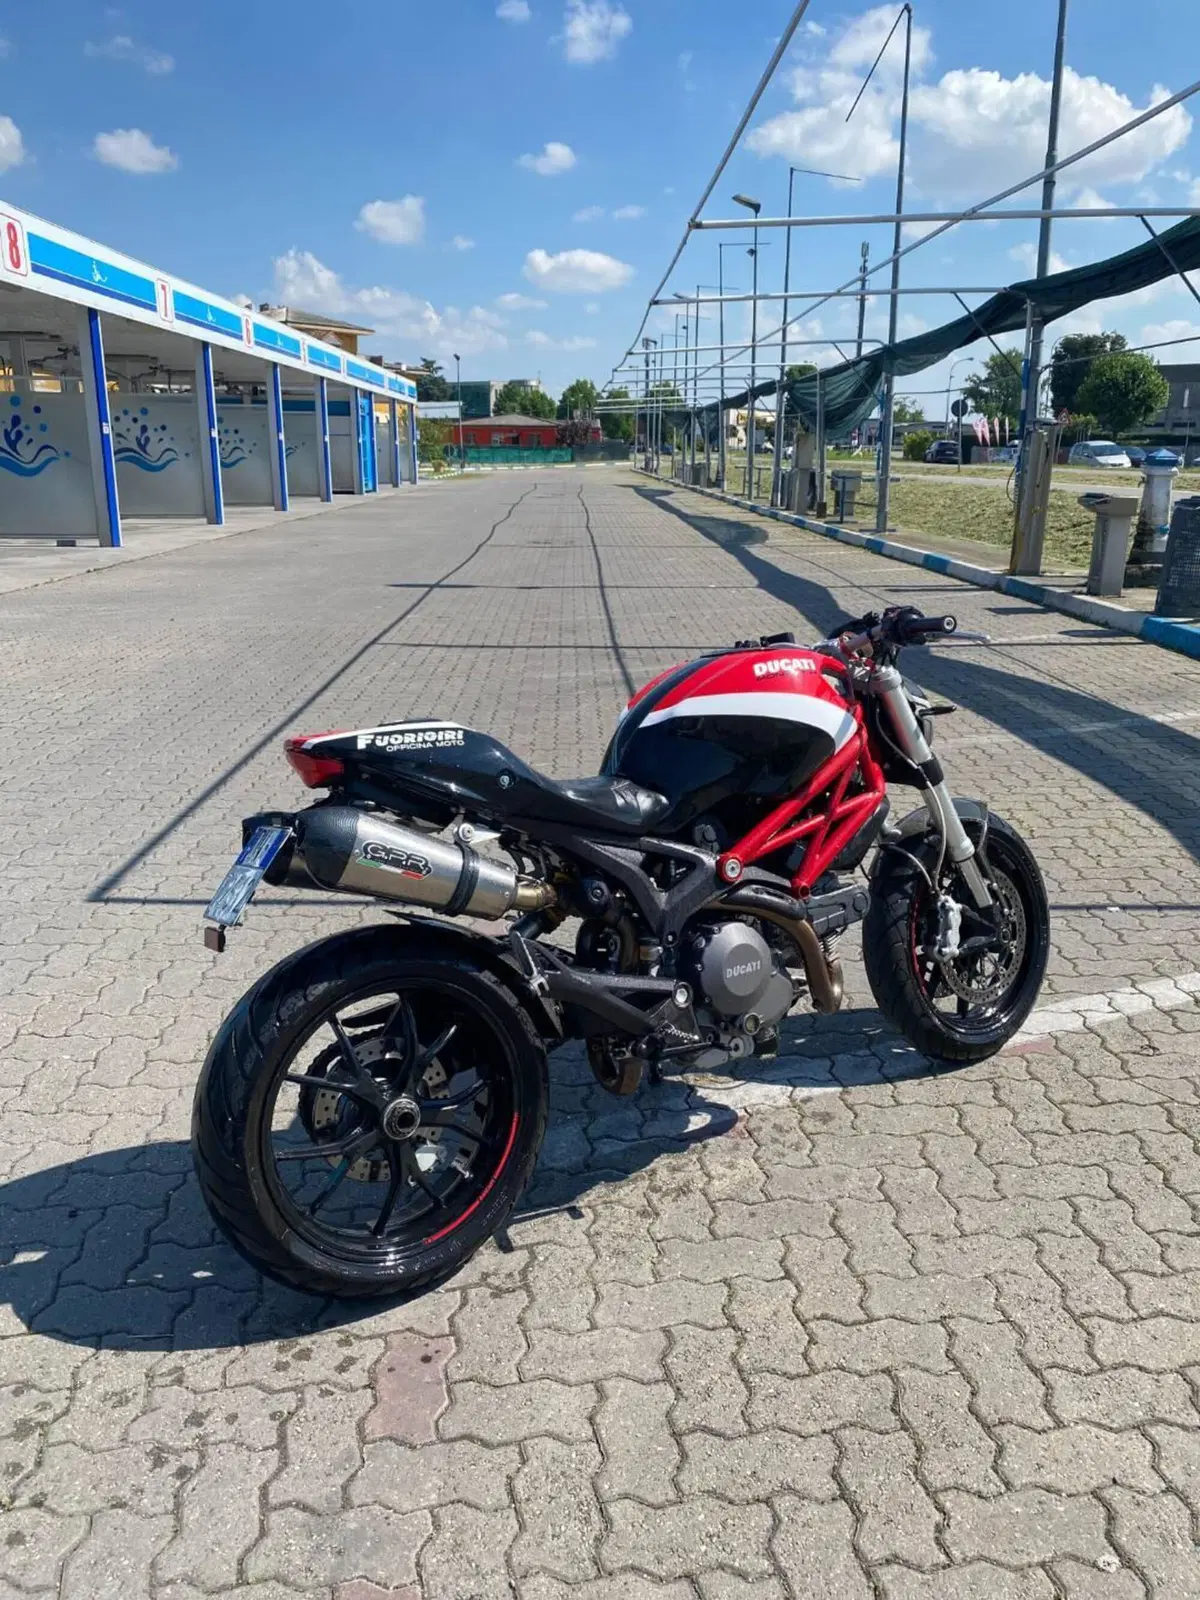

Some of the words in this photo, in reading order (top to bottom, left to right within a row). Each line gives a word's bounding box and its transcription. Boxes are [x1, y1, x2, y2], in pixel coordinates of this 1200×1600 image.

[6, 221, 21, 269] 8
[160, 283, 168, 318] 7
[753, 658, 816, 677] DUCATI
[386, 742, 433, 752] OFFICINA
[435, 739, 465, 747] MOTO
[726, 960, 761, 979] DUCATI
